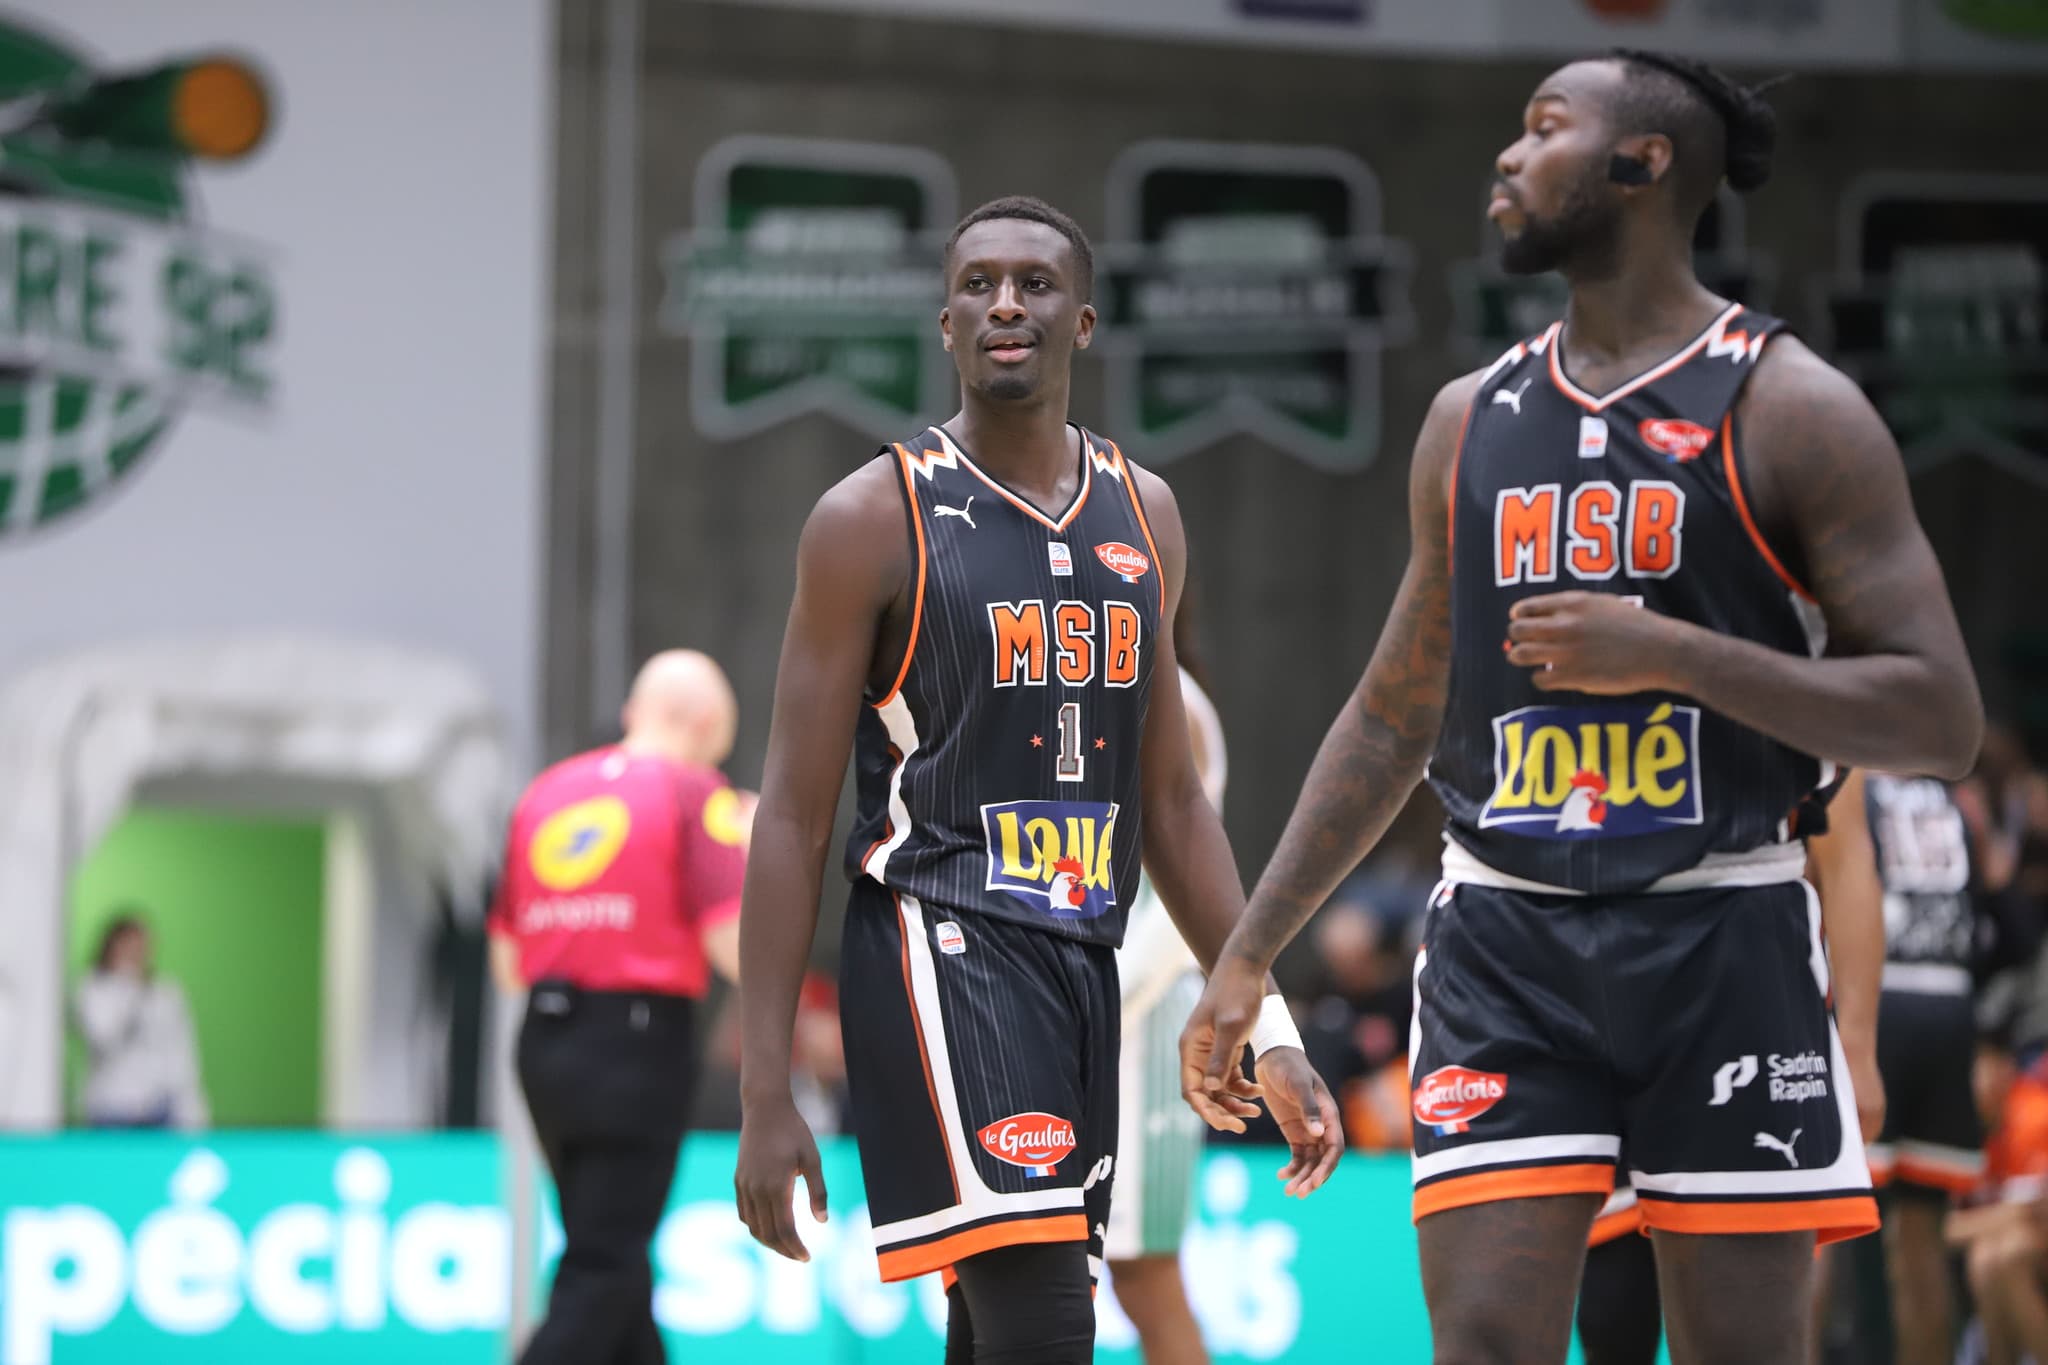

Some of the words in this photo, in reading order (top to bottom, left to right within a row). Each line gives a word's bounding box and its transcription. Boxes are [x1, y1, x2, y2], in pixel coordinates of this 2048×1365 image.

[1106, 546, 1148, 569] Gaulois
[1494, 480, 1686, 587] MSB
[987, 598, 1141, 688] MSB
[1056, 702, 1084, 782] 1
[1492, 702, 1686, 810] Loué
[1766, 1050, 1828, 1078] Sadrin
[1769, 1074, 1828, 1104] Rapin
[985, 1131, 998, 1145] le
[999, 1122, 1076, 1156] Gaulois
